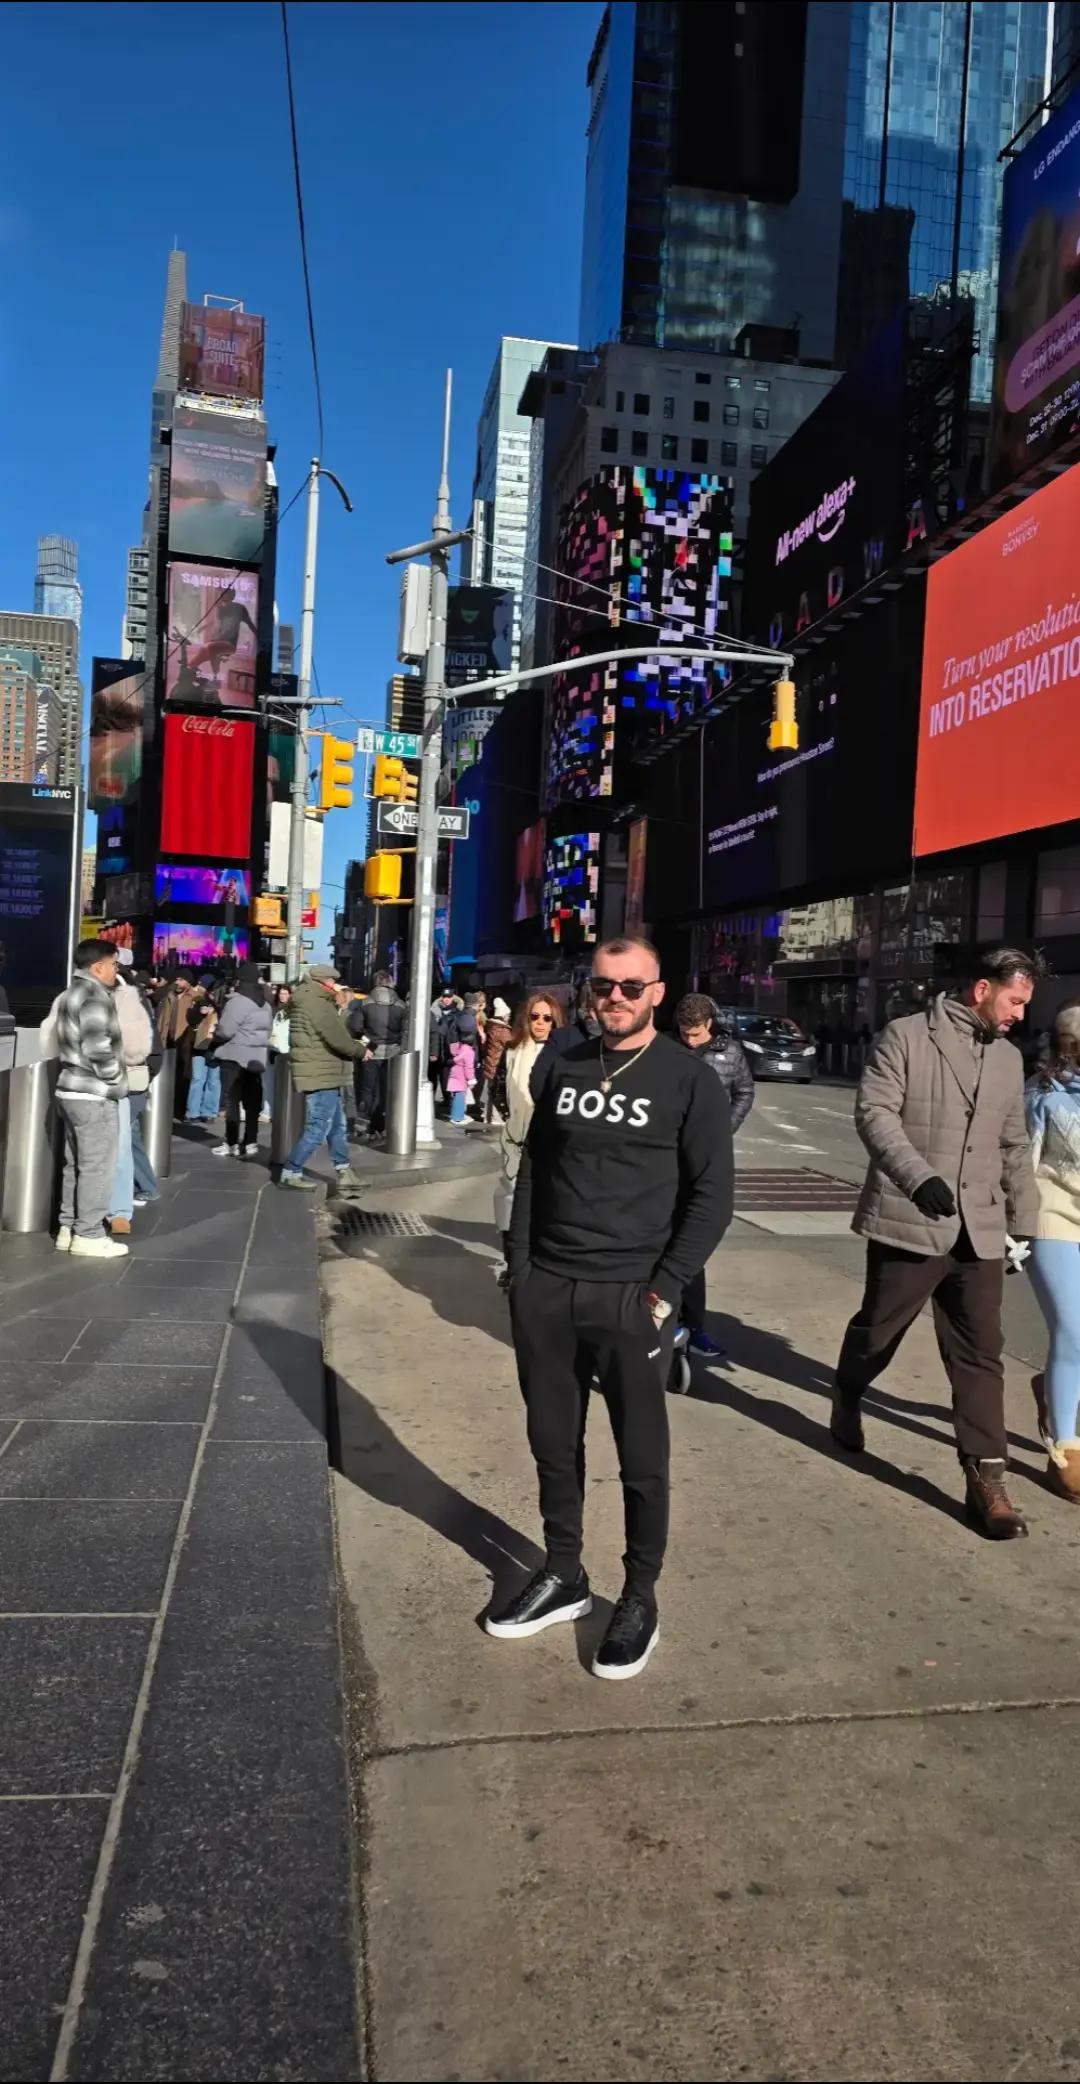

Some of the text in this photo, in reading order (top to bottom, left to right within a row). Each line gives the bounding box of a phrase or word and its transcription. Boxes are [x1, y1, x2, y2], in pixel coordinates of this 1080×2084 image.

[776, 476, 856, 566] All-new alexa+
[181, 572, 250, 592] SAMSUNG
[943, 657, 977, 689] Turn
[975, 634, 1014, 680] your
[451, 709, 484, 728] LITTLE
[929, 691, 965, 738] INTO
[375, 734, 385, 750] W
[389, 735, 404, 754] 45
[32, 788, 72, 799] LinkNYC
[393, 812, 457, 829] ONE AY
[556, 1086, 651, 1128] BOSS
